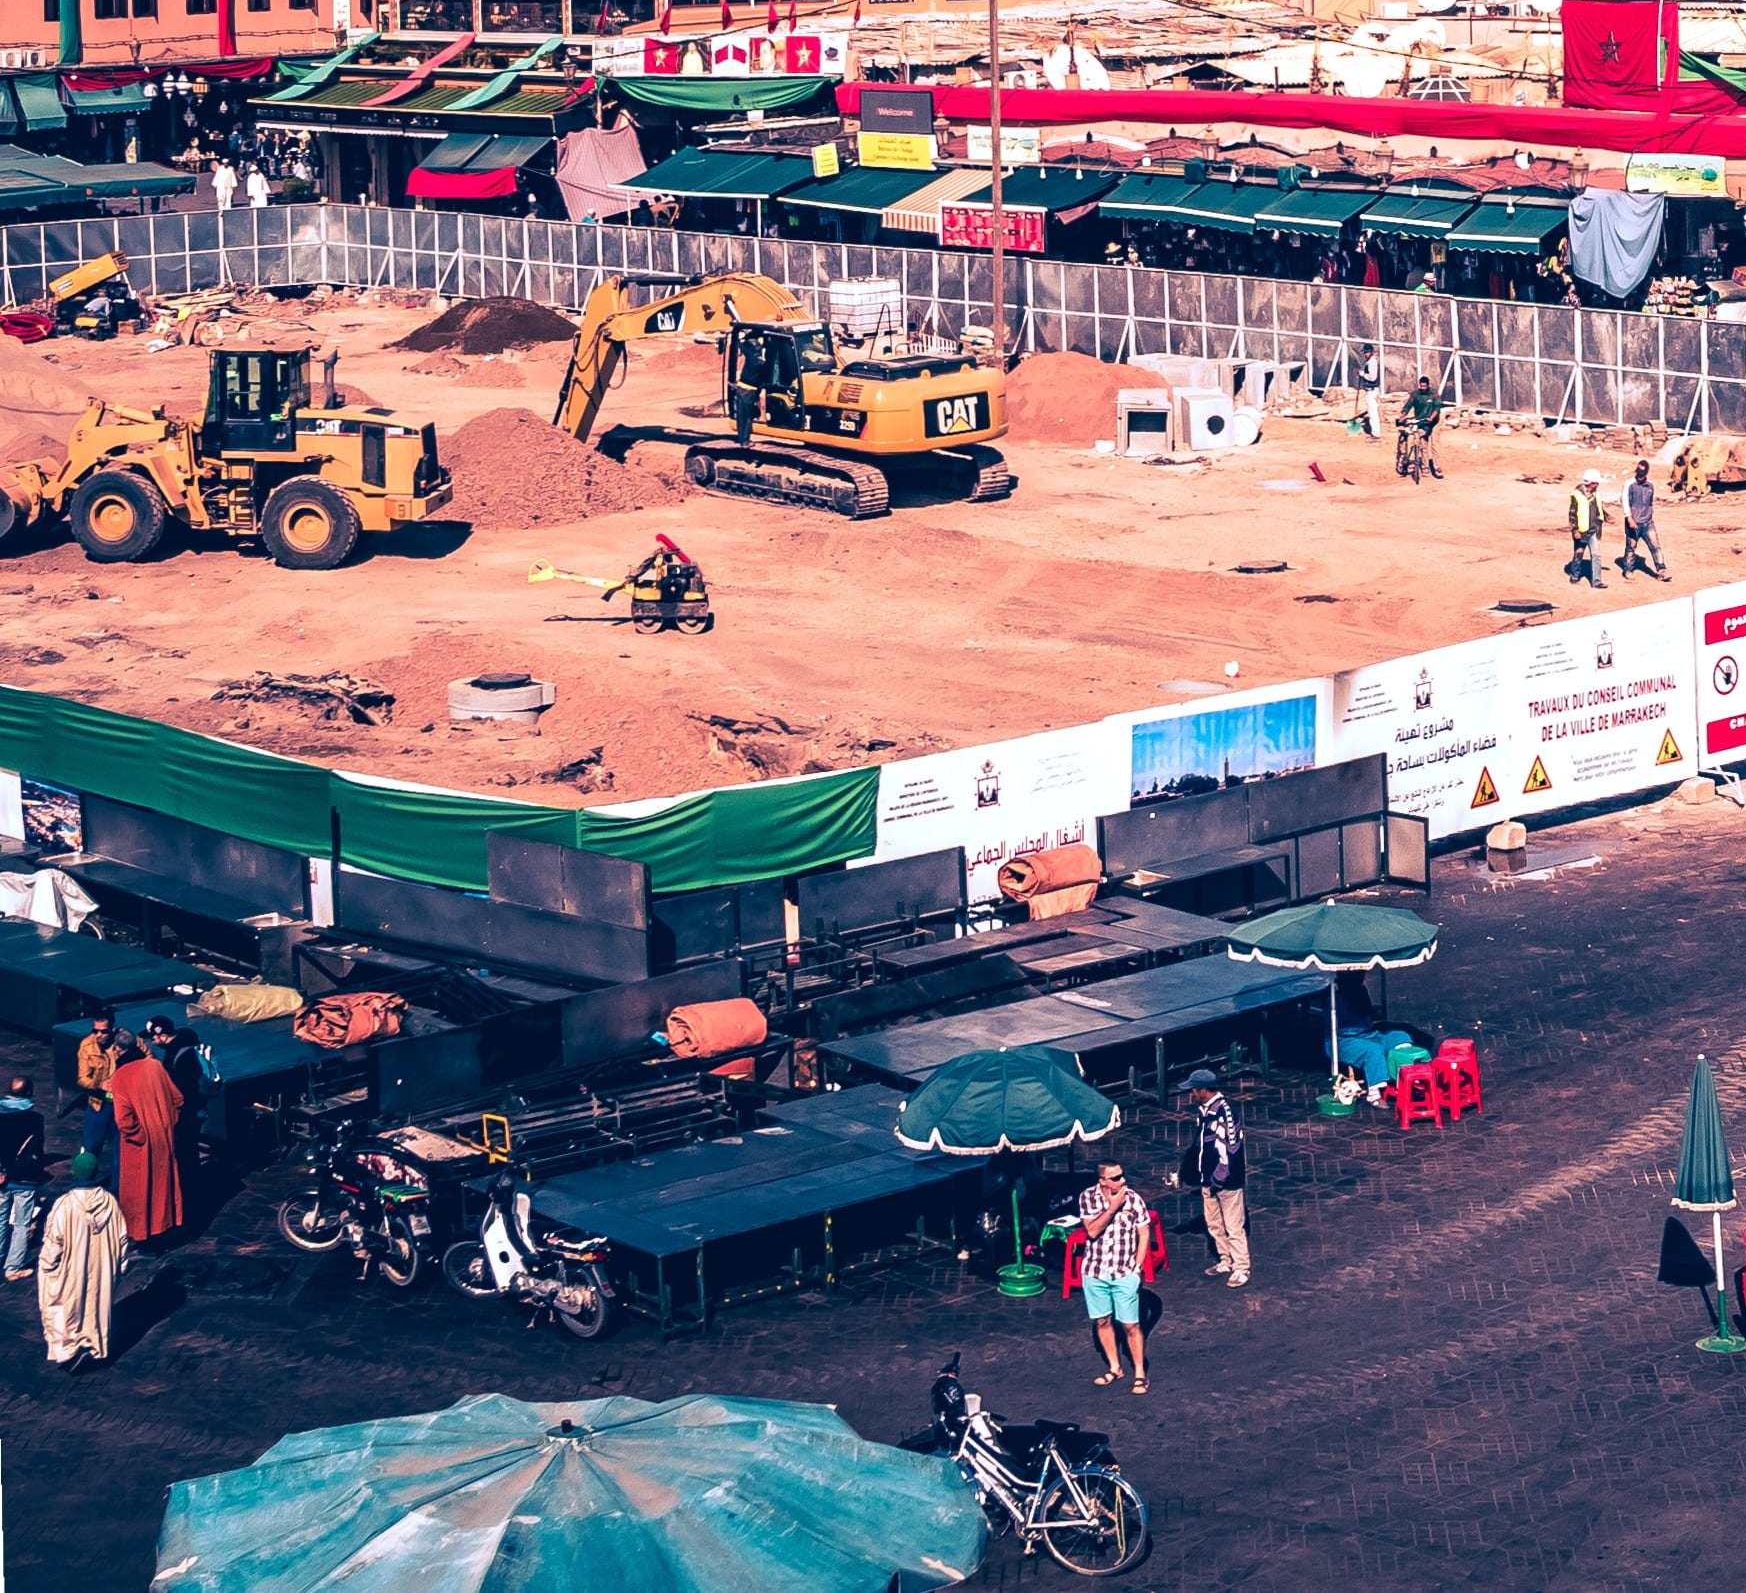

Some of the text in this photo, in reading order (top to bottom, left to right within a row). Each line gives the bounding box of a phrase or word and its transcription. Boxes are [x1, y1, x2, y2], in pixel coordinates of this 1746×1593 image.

[877, 108, 914, 117] Welcome
[315, 418, 342, 436] CAT
[937, 396, 979, 435] CAT
[1528, 674, 1677, 718] TRAVAUX DU CONSEIL COMMUNAL
[1422, 717, 1454, 740] مشروع
[1541, 702, 1667, 742] DE LA VILLE DE MARRAKECH
